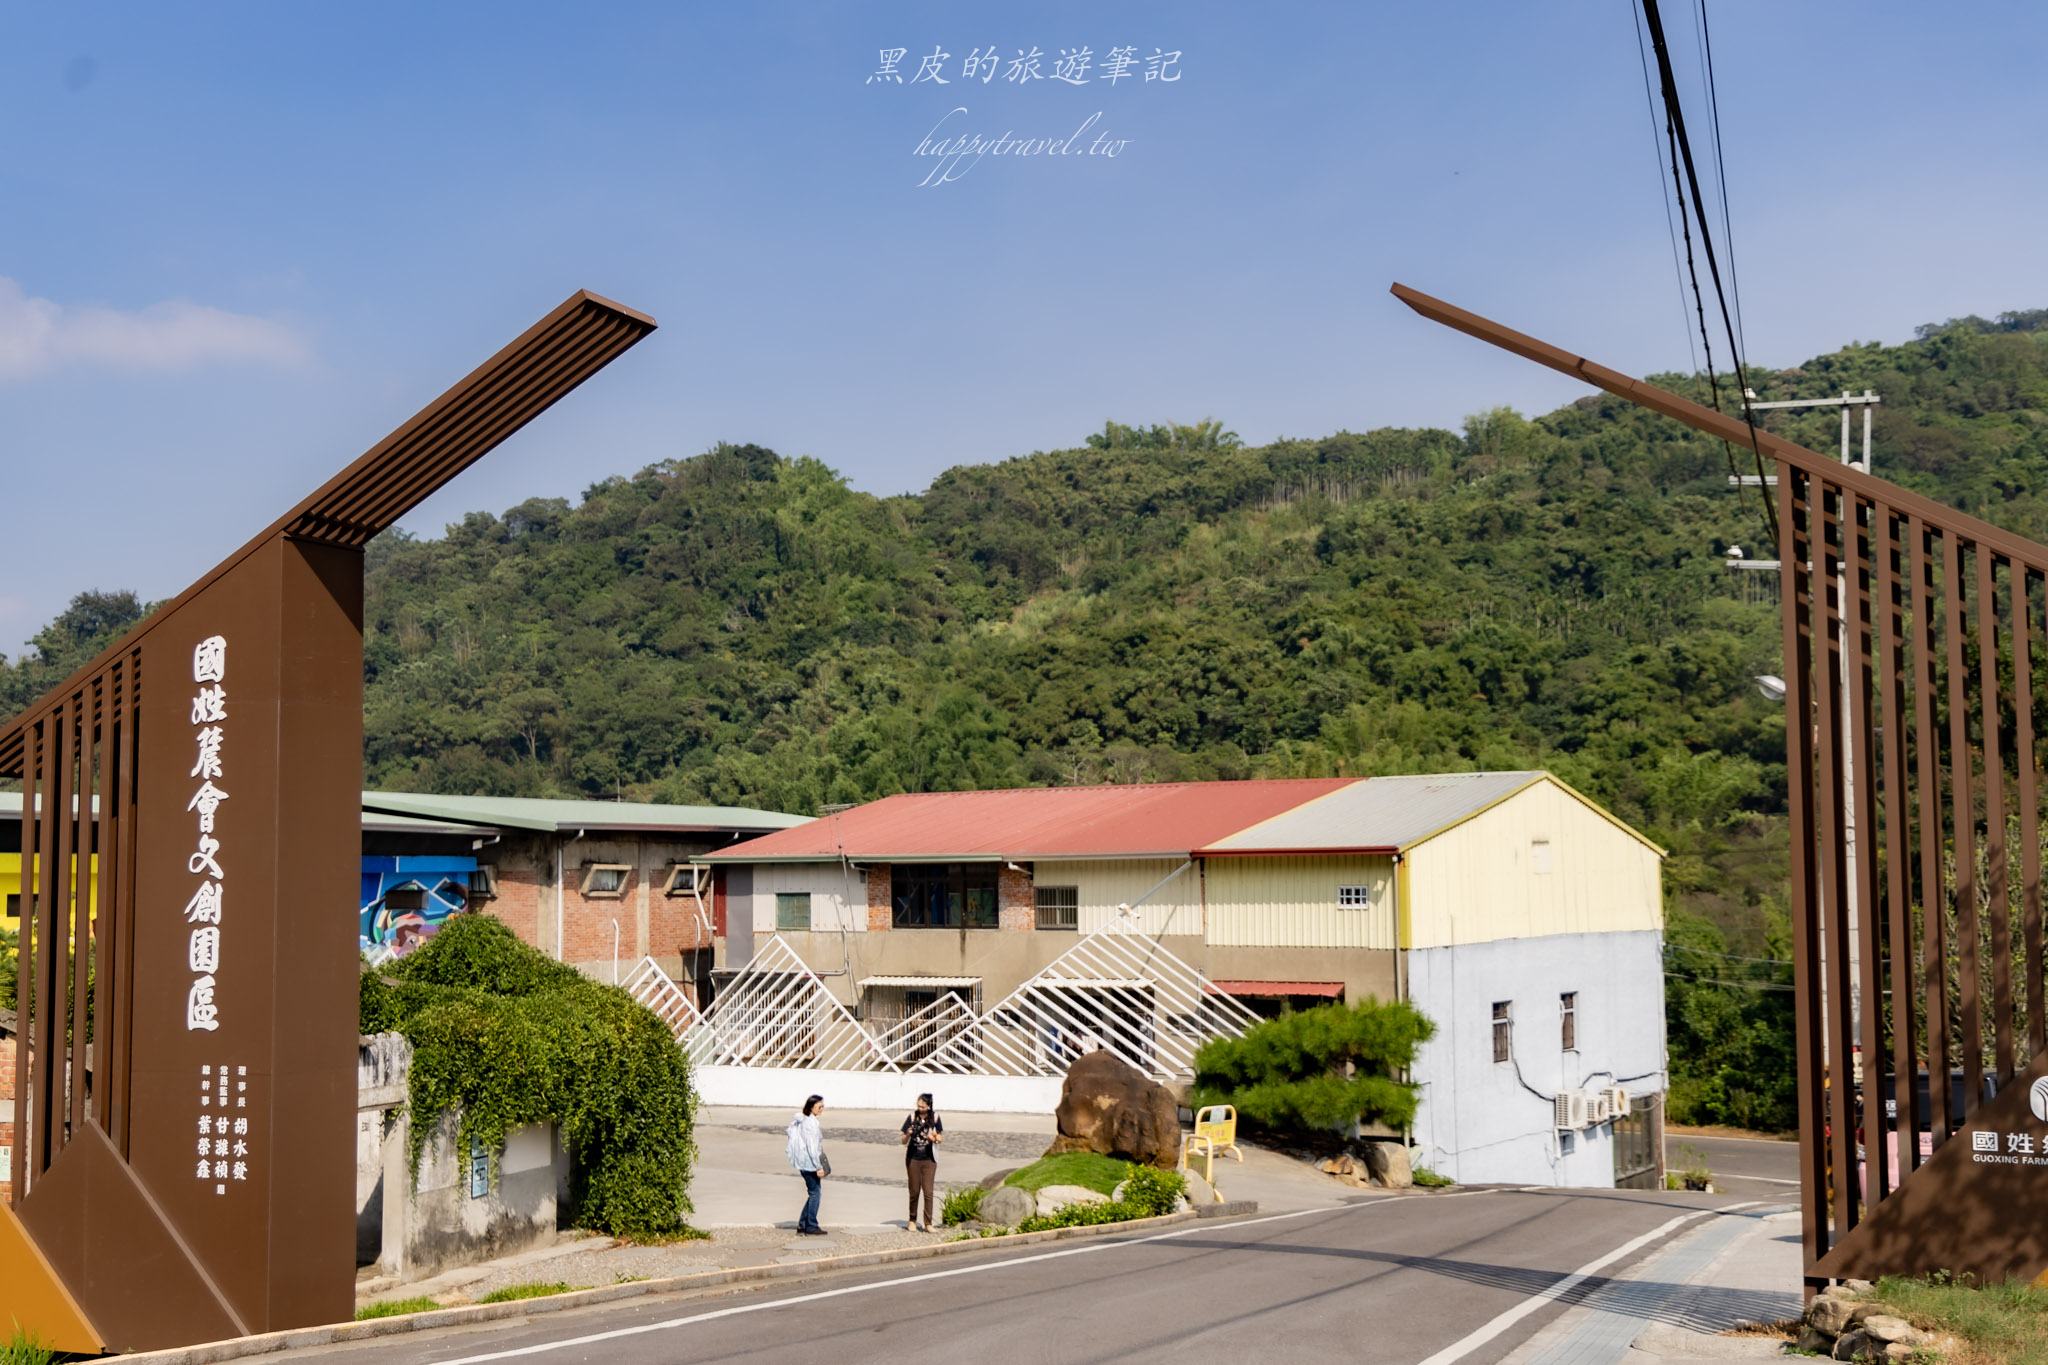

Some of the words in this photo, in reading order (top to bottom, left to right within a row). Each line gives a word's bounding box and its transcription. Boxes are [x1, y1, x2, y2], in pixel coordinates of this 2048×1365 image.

[183, 635, 230, 1032] 國姓農會文創園區
[232, 1117, 249, 1180] 胡水發
[1971, 1130, 2048, 1155] 國姓
[1972, 1153, 2019, 1164] GUOXING
